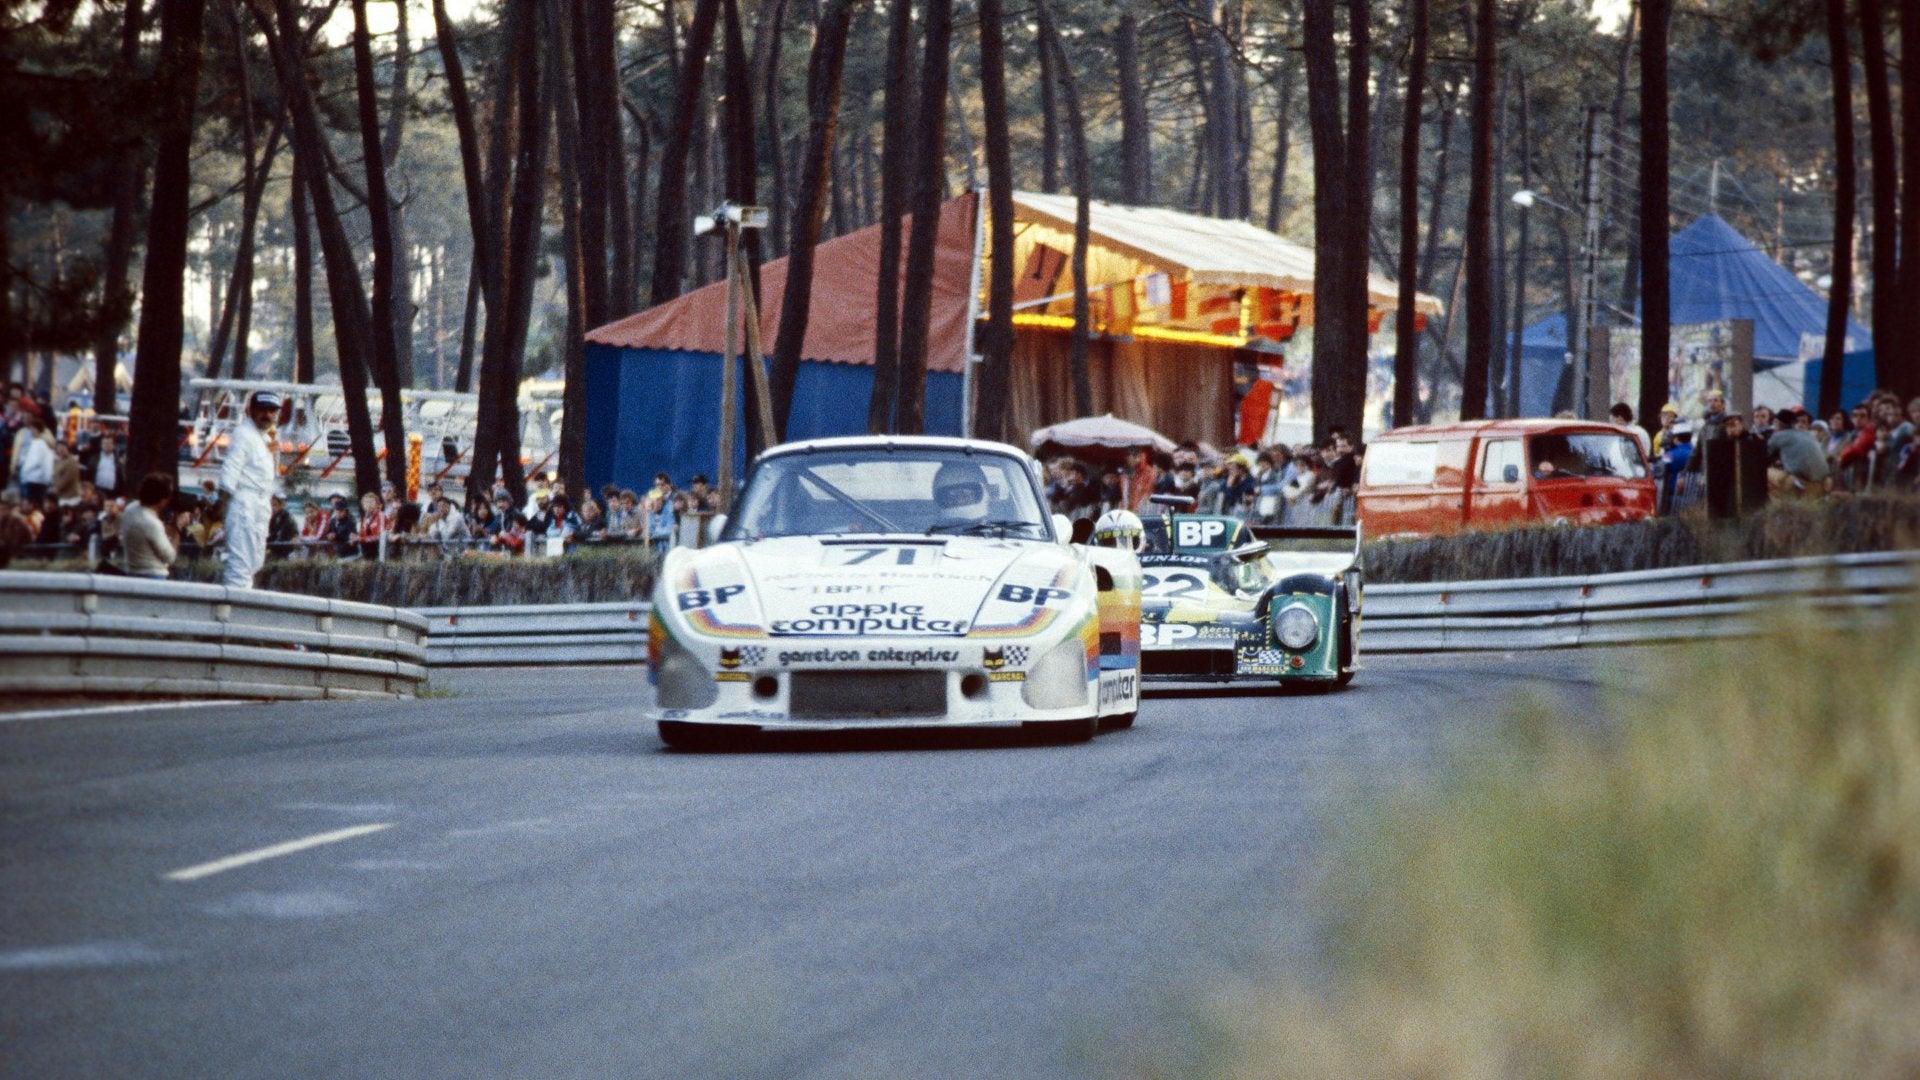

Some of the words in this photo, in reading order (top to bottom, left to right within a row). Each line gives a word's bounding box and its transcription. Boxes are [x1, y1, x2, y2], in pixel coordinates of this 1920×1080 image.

[1178, 520, 1225, 547] BP
[843, 548, 917, 566] 71
[677, 584, 746, 612] BP
[997, 583, 1071, 606] BP
[810, 602, 925, 618] apple
[770, 616, 969, 636] computer
[778, 647, 861, 666] garretson
[867, 646, 960, 665] enterprises
